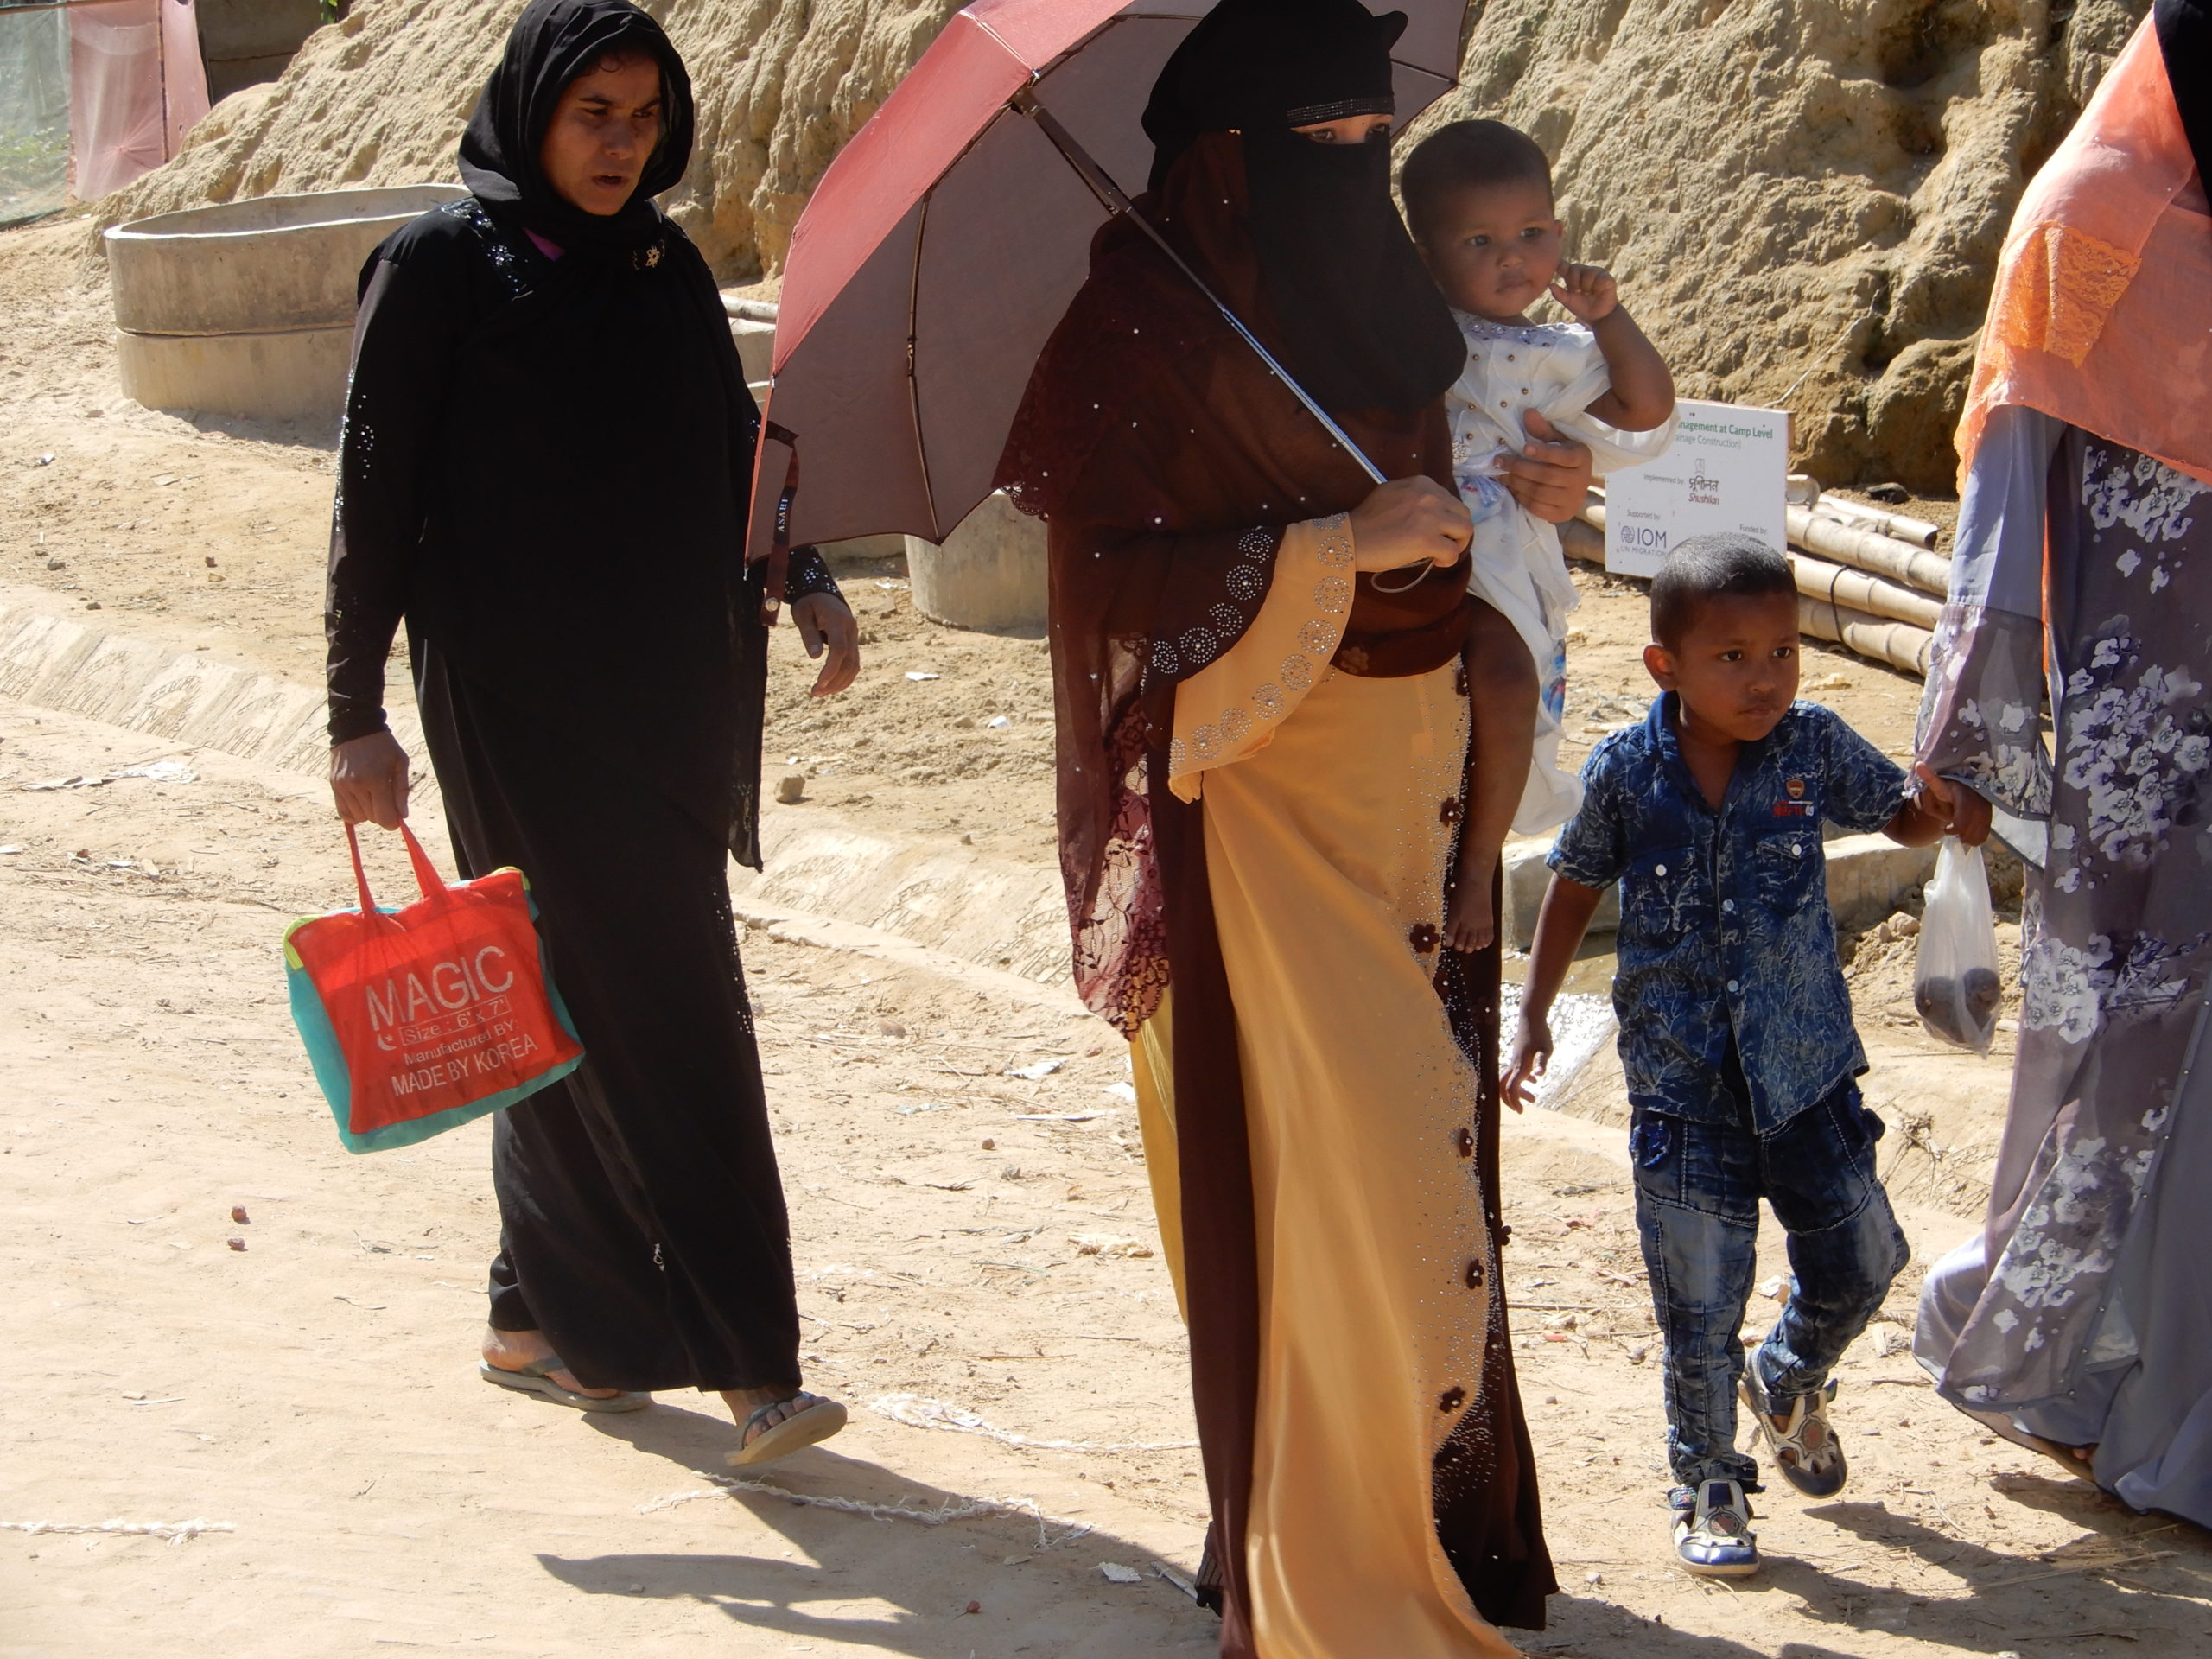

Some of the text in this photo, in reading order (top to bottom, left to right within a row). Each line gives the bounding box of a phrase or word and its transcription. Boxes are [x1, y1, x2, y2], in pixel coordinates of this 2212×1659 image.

[1728, 425, 1751, 437] Camp
[1752, 427, 1773, 439] Level
[1697, 435, 1741, 449] Construction)
[1644, 474, 1676, 484] Implemented
[1688, 493, 1719, 505] Shushilan
[778, 499, 788, 532] ASAHI
[1627, 510, 1654, 518] Supported
[1740, 524, 1759, 533] Funded
[1637, 528, 1666, 548] IOM
[365, 945, 514, 1031] MAGIC
[404, 1025, 440, 1043] Size
[404, 1029, 492, 1065] Manufactured
[391, 1033, 538, 1096] MADE BY KOREA
